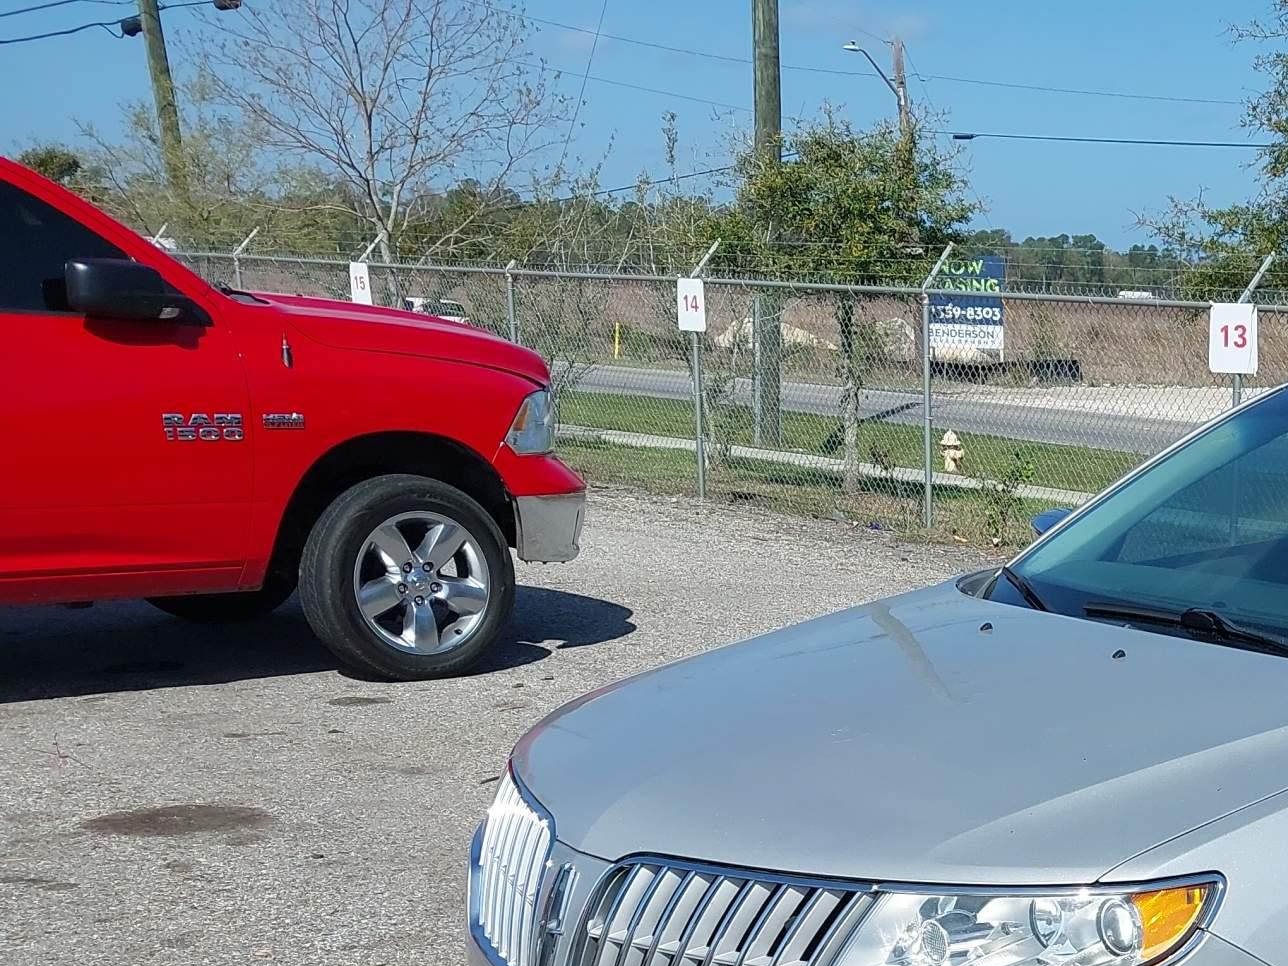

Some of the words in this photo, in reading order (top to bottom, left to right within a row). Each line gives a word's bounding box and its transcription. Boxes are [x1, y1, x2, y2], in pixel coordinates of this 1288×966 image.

[354, 275, 366, 290] 15
[683, 294, 700, 313] 14
[928, 328, 994, 339] BENDERSON
[1220, 325, 1247, 349] 13
[162, 413, 243, 426] RAM
[164, 427, 244, 441] 1500
